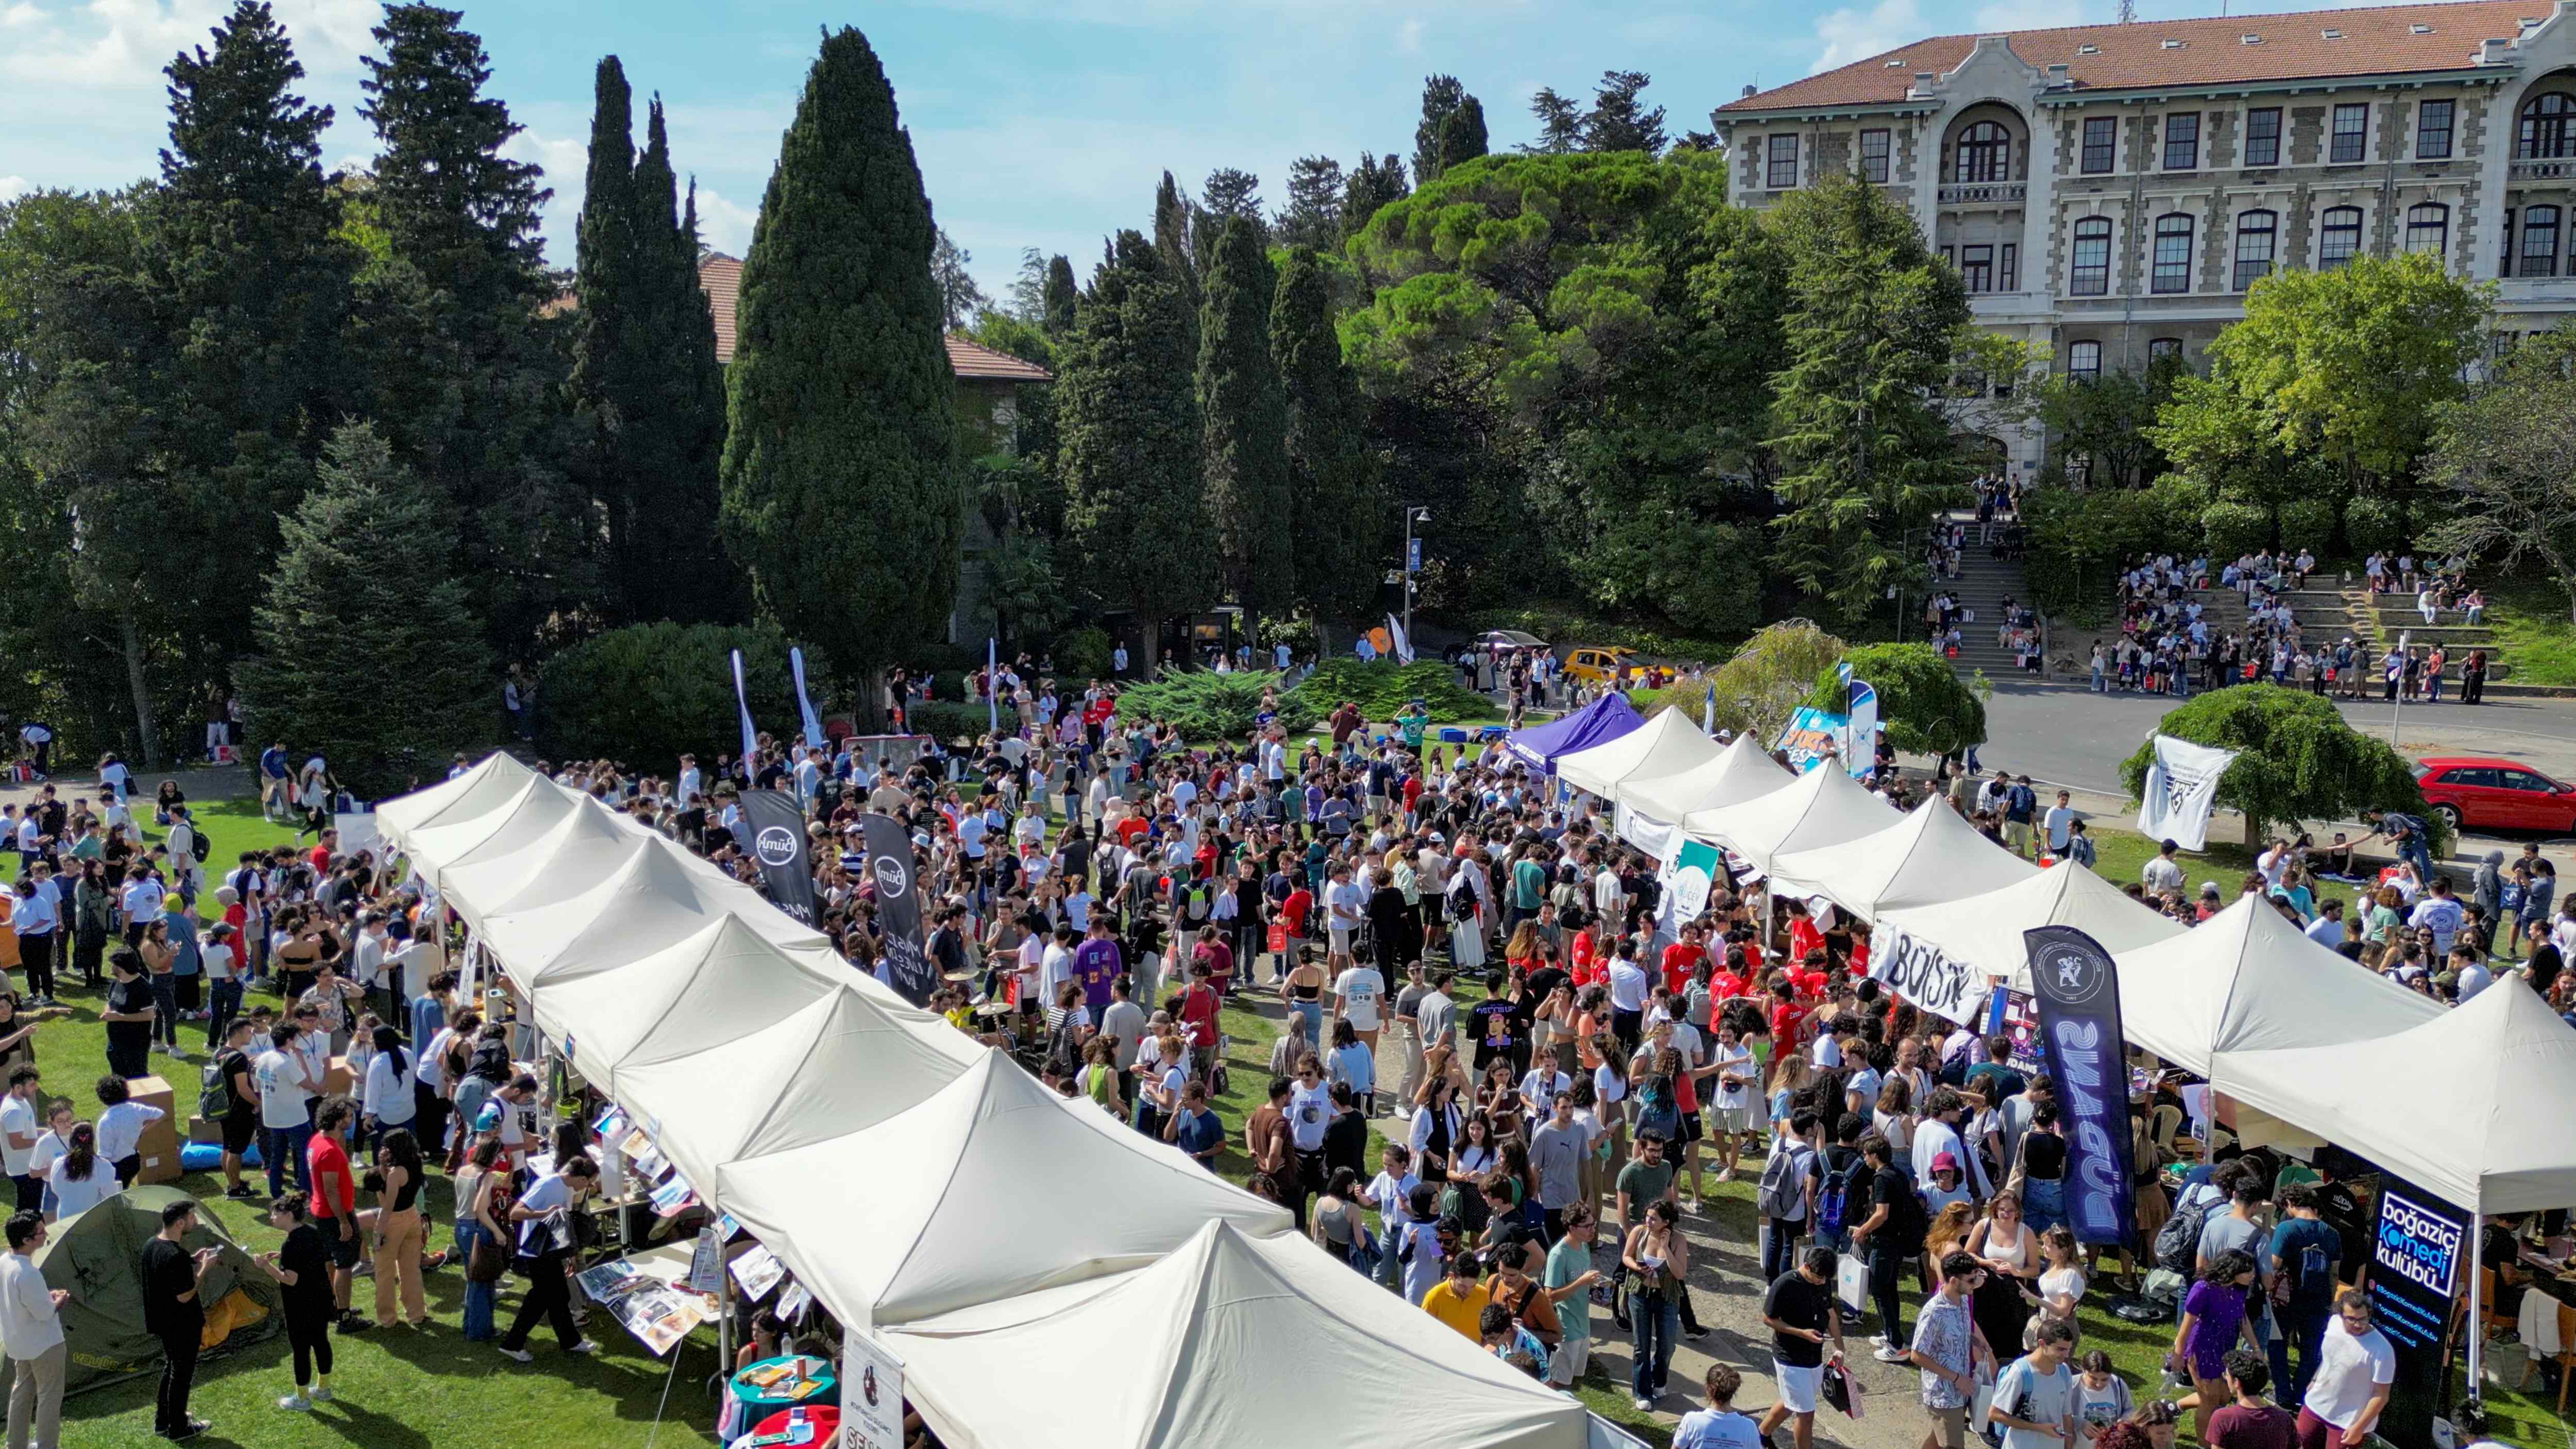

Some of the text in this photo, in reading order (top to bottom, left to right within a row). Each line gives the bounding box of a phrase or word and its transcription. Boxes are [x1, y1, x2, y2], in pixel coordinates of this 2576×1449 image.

[2006, 1058, 2038, 1075] DANS
[2379, 1218, 2447, 1279] Komedi
[2382, 1196, 2462, 1256] boğaziçi
[2376, 1240, 2437, 1288] kulübü
